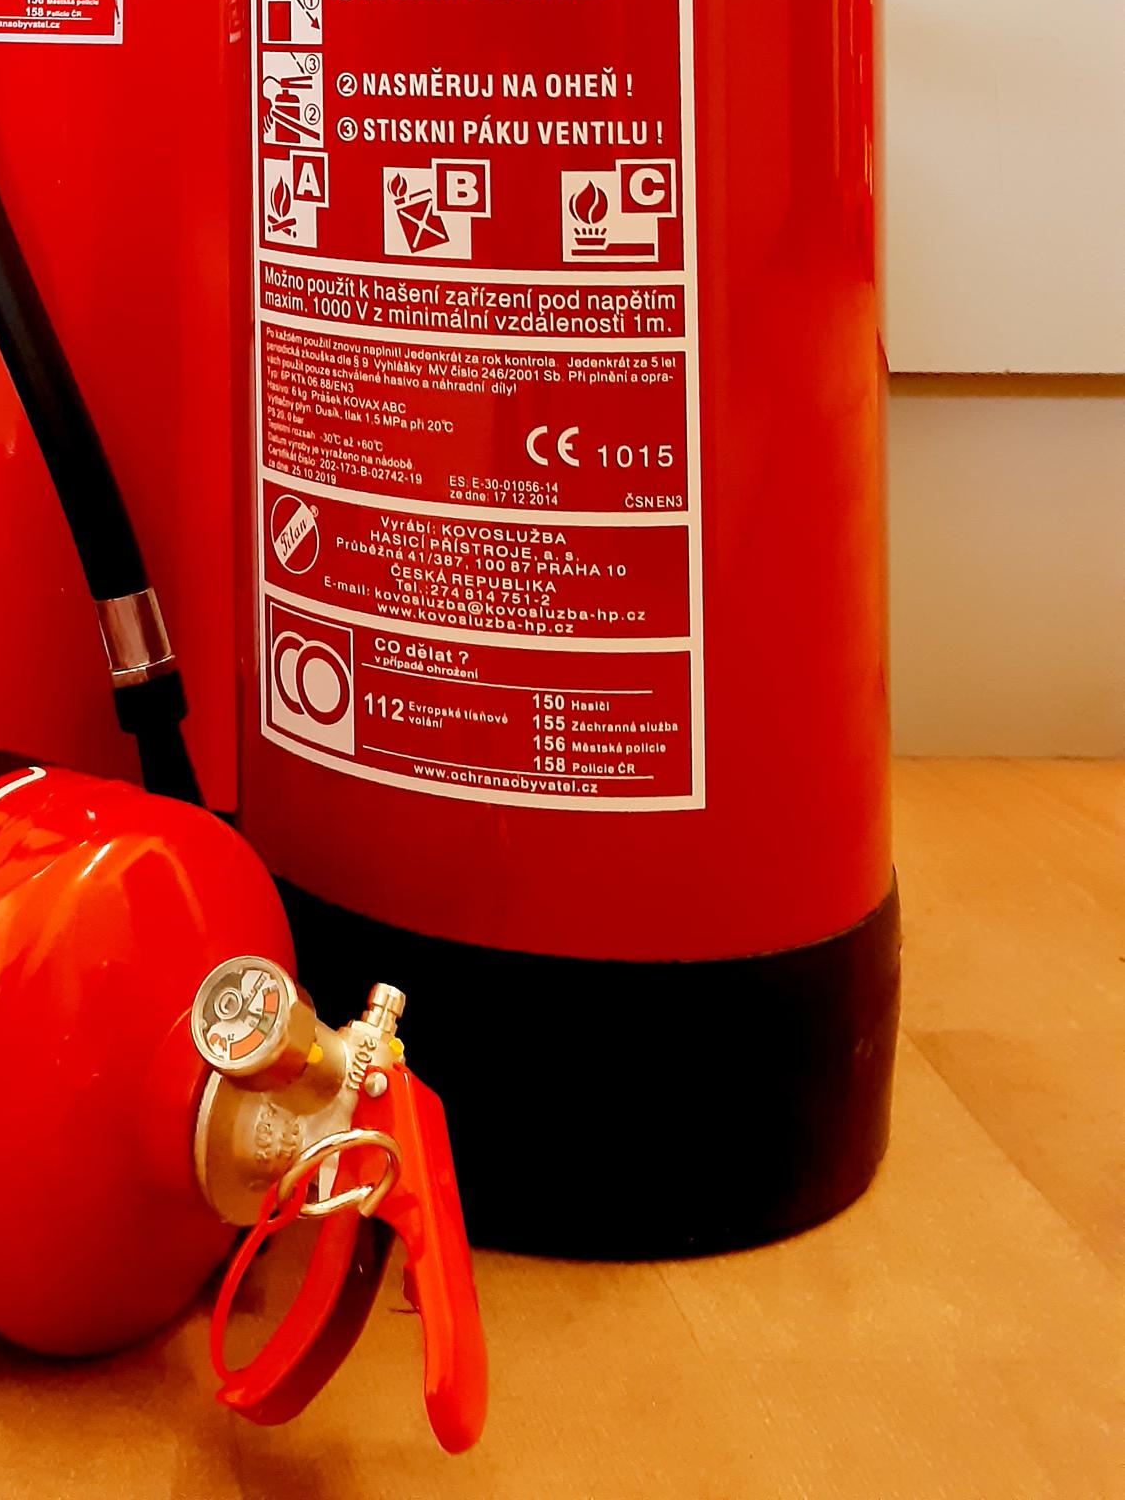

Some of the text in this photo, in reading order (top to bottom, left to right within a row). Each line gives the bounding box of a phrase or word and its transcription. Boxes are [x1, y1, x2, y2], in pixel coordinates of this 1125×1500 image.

[26, 7, 44, 17] 158
[361, 66, 618, 98] NASMĚRUJ NA OHEŇ
[362, 114, 649, 146] STISKNI PÁKU VENTILU
[295, 162, 321, 198] A
[445, 170, 480, 207] B
[628, 166, 668, 206] C
[264, 266, 676, 315] Možno použít k hašení zařízení pod napětím
[264, 290, 625, 335] maxim. 1000 V z minimální vzdálenosti
[404, 348, 676, 369] Jedenkrát rok Jedenkrát za 5 let
[383, 371, 485, 393] hasivo náhradní
[428, 364, 448, 376] MV
[450, 364, 478, 378] číslo
[481, 367, 540, 382] 246/2001
[568, 371, 586, 382] Při
[589, 370, 628, 385] plnění
[640, 373, 674, 385] opra-
[343, 393, 406, 414] KOVAX ABC
[525, 425, 674, 468] CE 1015
[471, 476, 559, 493] E-30-01056-14
[379, 515, 567, 545] Vyrábí: KOVOSLUŽBA
[335, 536, 627, 577] Průběžná 41/387, 100 87 PRAHA 10
[369, 530, 539, 561] HASICÍ PŘÍSTROJE,
[390, 562, 557, 594] ČESKÁ REPUBLIKA
[323, 575, 646, 623] E-mail: kovosluzba@kovosluzba-hp.cz
[464, 588, 551, 607] 814 751-2
[376, 602, 575, 636] www.kovosluzba-hp.cz
[374, 636, 454, 664] CO dělat
[382, 655, 480, 680] případě ohrožení
[363, 691, 462, 723] 112 Evropské
[531, 693, 610, 712] 150 Hasiči
[408, 713, 444, 729] volání
[531, 714, 679, 733] 155 Záchranná služba
[532, 734, 667, 756] 156 Městská policie
[412, 763, 599, 794] www.ochranaobyvatel.cz
[532, 754, 636, 775] 158 Policie ČR
